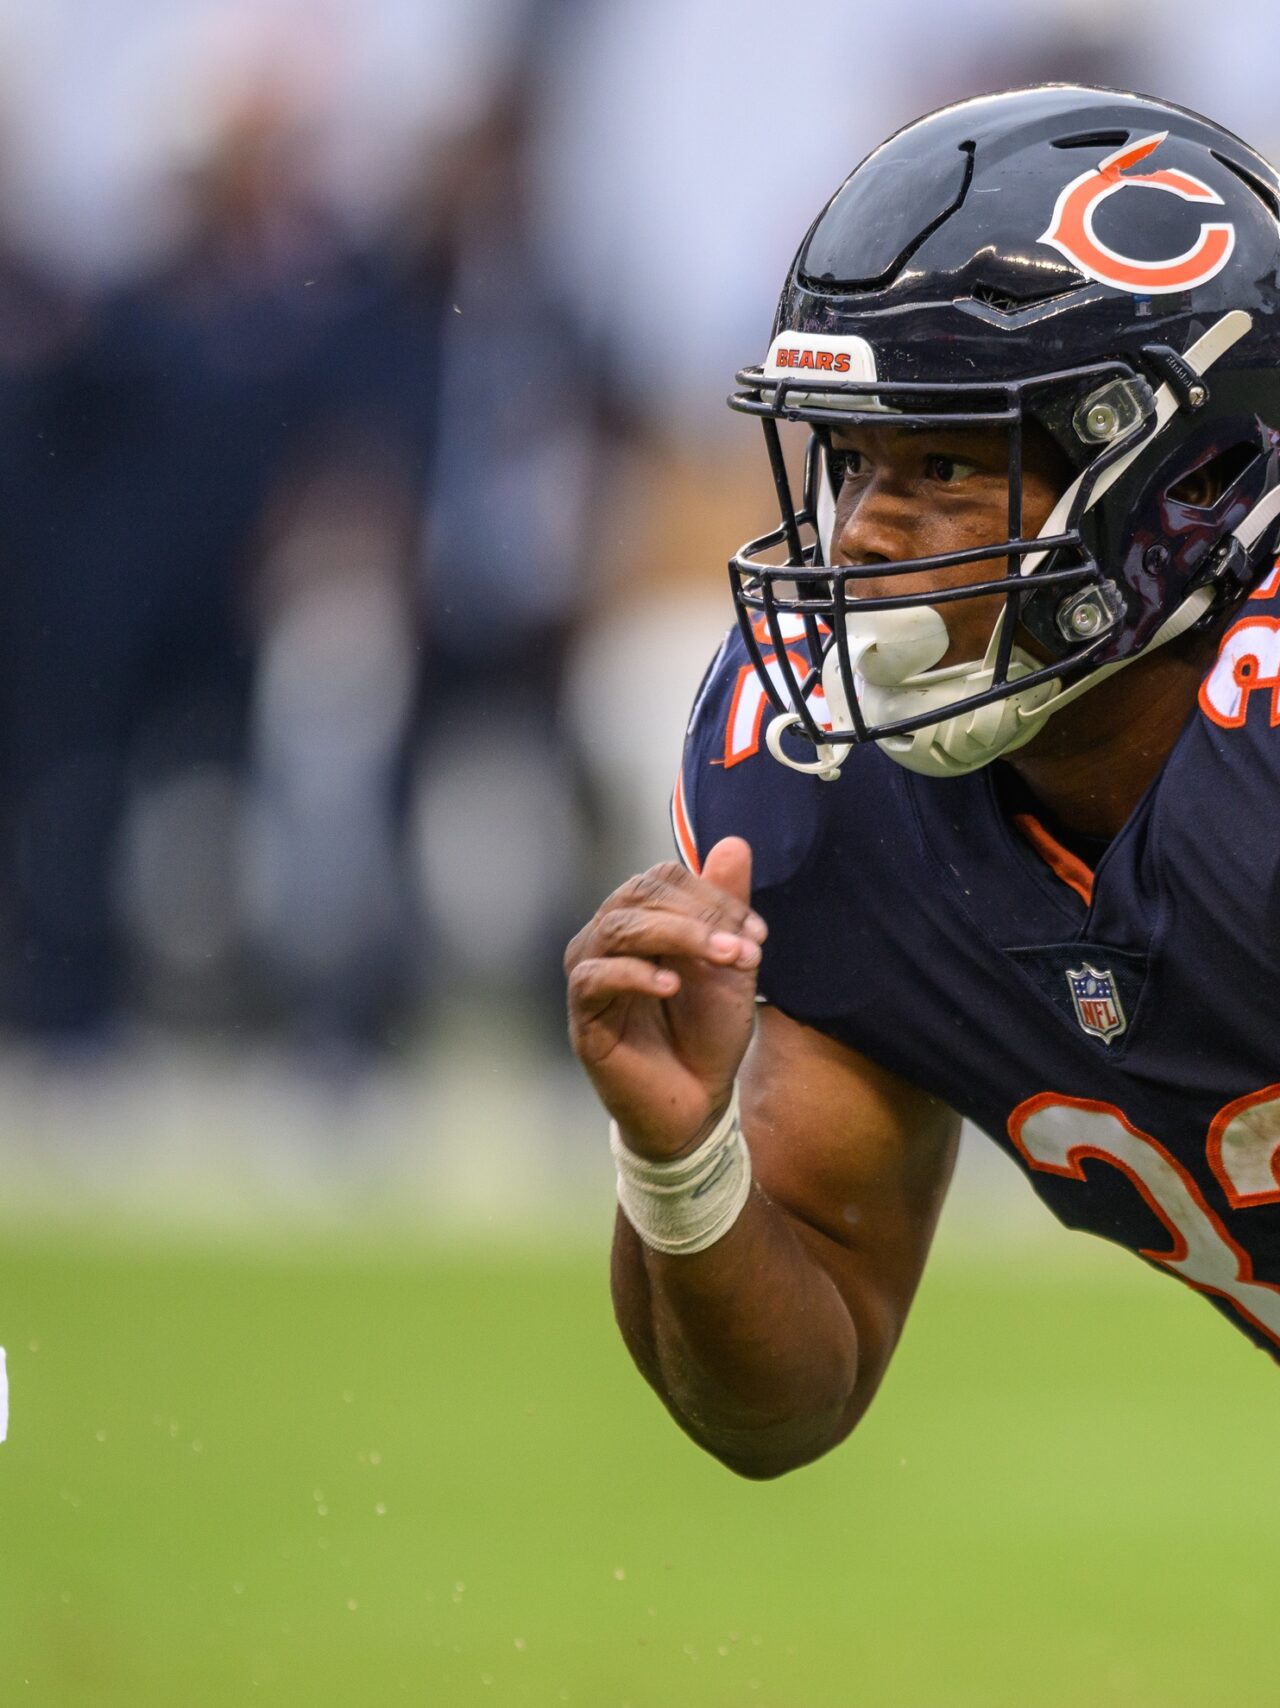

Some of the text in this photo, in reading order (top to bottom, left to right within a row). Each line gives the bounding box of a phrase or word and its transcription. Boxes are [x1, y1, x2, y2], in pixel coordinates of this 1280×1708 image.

[1036, 131, 1235, 294] C
[776, 348, 852, 373] BEARS
[1080, 1001, 1118, 1030] NFL
